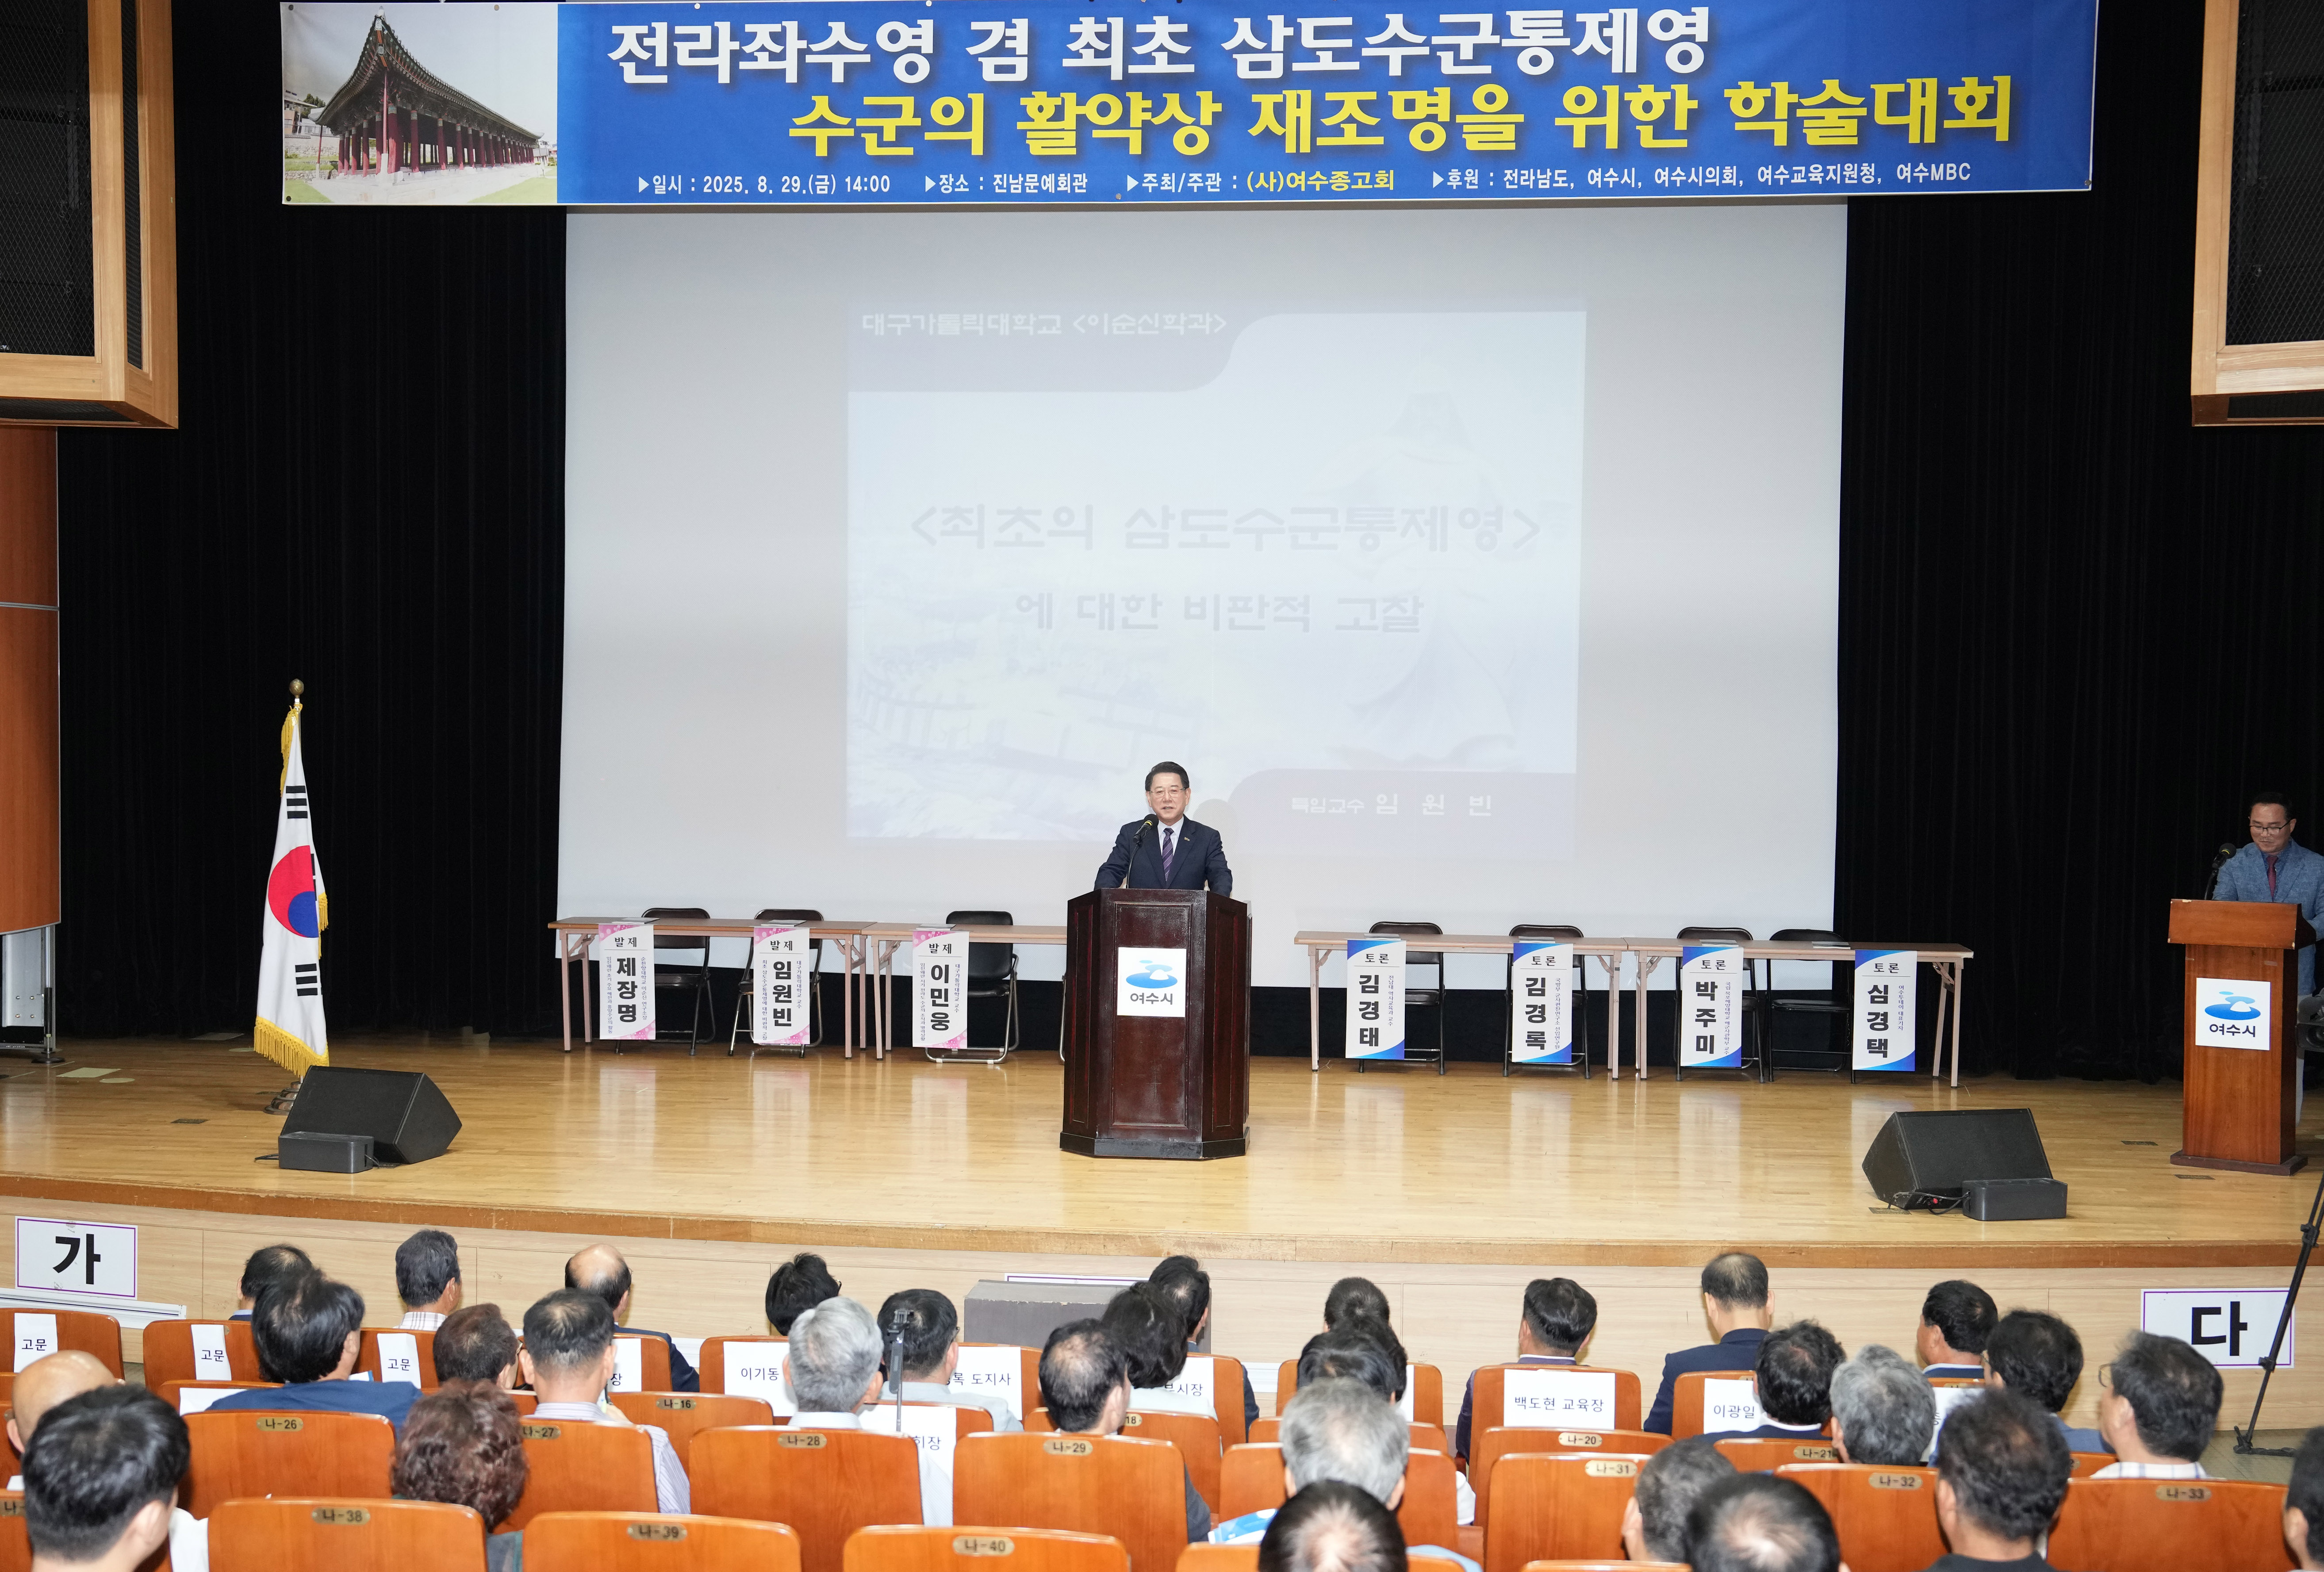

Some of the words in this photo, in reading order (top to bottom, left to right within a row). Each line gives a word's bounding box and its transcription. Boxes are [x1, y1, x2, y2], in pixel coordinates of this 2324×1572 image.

[608, 19, 933, 83] 전라좌수영
[966, 19, 1028, 81] 겸
[1062, 16, 1194, 80] 최초
[1221, 7, 1708, 78] 삼도수군통제영
[789, 93, 983, 156] 수군의
[1017, 91, 1222, 155] 활약상
[1248, 84, 1524, 153] 재조명을
[1555, 84, 1698, 149] 위한
[1724, 76, 2010, 146] 학술대회
[1143, 173, 1221, 192] 주최/주관
[1247, 170, 1393, 192] (사)여수종고회
[1447, 169, 1478, 189] 후원
[1504, 169, 1574, 189] 전라남도,
[1588, 168, 1641, 188] 여수시,
[1655, 166, 1742, 187] 여수시의회,
[1758, 164, 1881, 185] 여수교육지원청,
[1897, 163, 1970, 183] 여수MBC
[653, 175, 681, 194] 일시
[704, 176, 748, 194] 2025.
[758, 176, 772, 194] 8.
[782, 174, 836, 194] 29.(금)
[846, 176, 890, 192] 14:00
[940, 174, 969, 193] 장소
[993, 173, 1087, 193] 진남문예회관
[863, 313, 1062, 336] 대구가톨릭대학교
[1072, 313, 1227, 336] <이순신학과>
[911, 505, 1095, 550] <최초의
[1124, 505, 1541, 552] 삼도수군통제영>
[1016, 591, 1053, 629] 에
[1078, 593, 1162, 629] 대한
[1185, 594, 1311, 632] 비판적
[1335, 595, 1423, 633] 고찰
[1292, 798, 1364, 813] 특임교수
[763, 960, 767, 968] 최초
[617, 958, 637, 1022] 제장명
[773, 962, 791, 1026] 임원빈
[797, 1000, 802, 1008] 교수
[931, 965, 949, 1031] 이민웅
[1130, 993, 1173, 1005] 여수시
[762, 1007, 767, 1016] 대한
[954, 1004, 959, 1013] 교수
[1359, 975, 1379, 1047] 김경태
[1525, 978, 1546, 1050] 김경록
[1388, 1017, 1393, 1026] 교수
[1695, 982, 1718, 1054] 박주미
[1867, 985, 1888, 1058] 심경택
[2209, 1024, 2255, 1037] 여수시
[53, 1234, 101, 1284] 가
[2192, 1301, 2247, 1356] 다
[22, 1339, 46, 1350] 고문
[202, 1350, 224, 1361] 고문
[387, 1358, 411, 1371] 고문
[741, 1368, 779, 1381] 이기동
[947, 1373, 964, 1385] 록
[971, 1373, 1011, 1385] 도지사
[664, 1399, 691, 1409] 나-16
[1515, 1396, 1555, 1411] 백도현
[1562, 1398, 1604, 1413] 교육장
[1714, 1405, 1754, 1419] 이광일
[265, 1419, 297, 1430] 나-26
[523, 1427, 554, 1437] 나-27
[787, 1436, 821, 1446] 나-28
[1568, 1435, 1596, 1445] 나-20
[1053, 1443, 1086, 1453] 나-29
[1803, 1449, 1832, 1458] 나-21
[1596, 1464, 1630, 1475] 나-31
[1879, 1476, 1915, 1487] 나-32
[2166, 1488, 2205, 1499] 나-33
[322, 1510, 363, 1522] 나-38
[638, 1526, 679, 1538] 나-39
[964, 1540, 1006, 1552] 나-40
